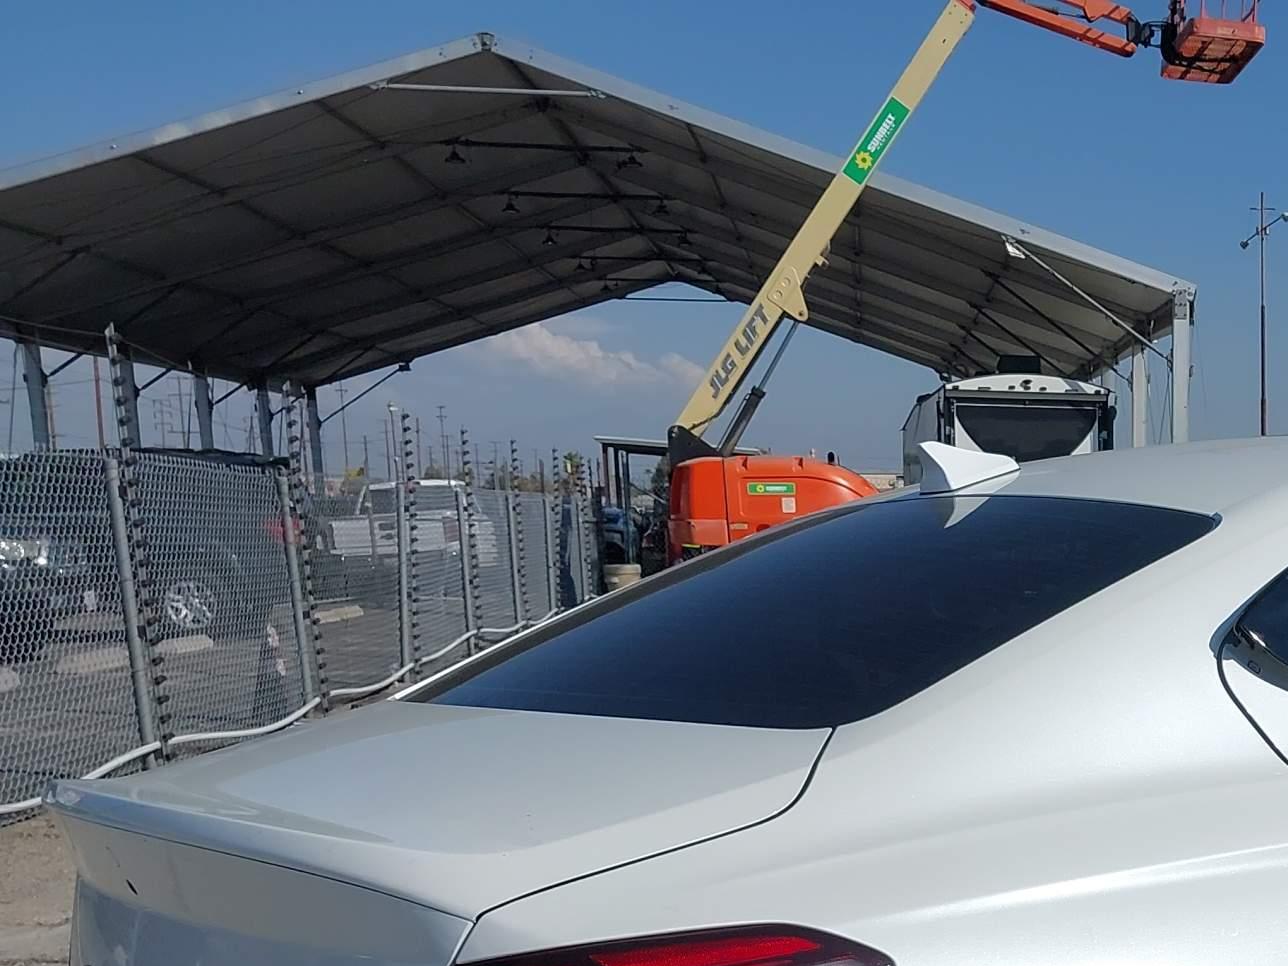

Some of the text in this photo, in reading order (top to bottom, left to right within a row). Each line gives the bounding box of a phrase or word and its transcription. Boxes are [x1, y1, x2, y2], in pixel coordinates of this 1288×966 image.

[867, 112, 896, 153] SUNBELT
[710, 303, 769, 399] JLG LIFT
